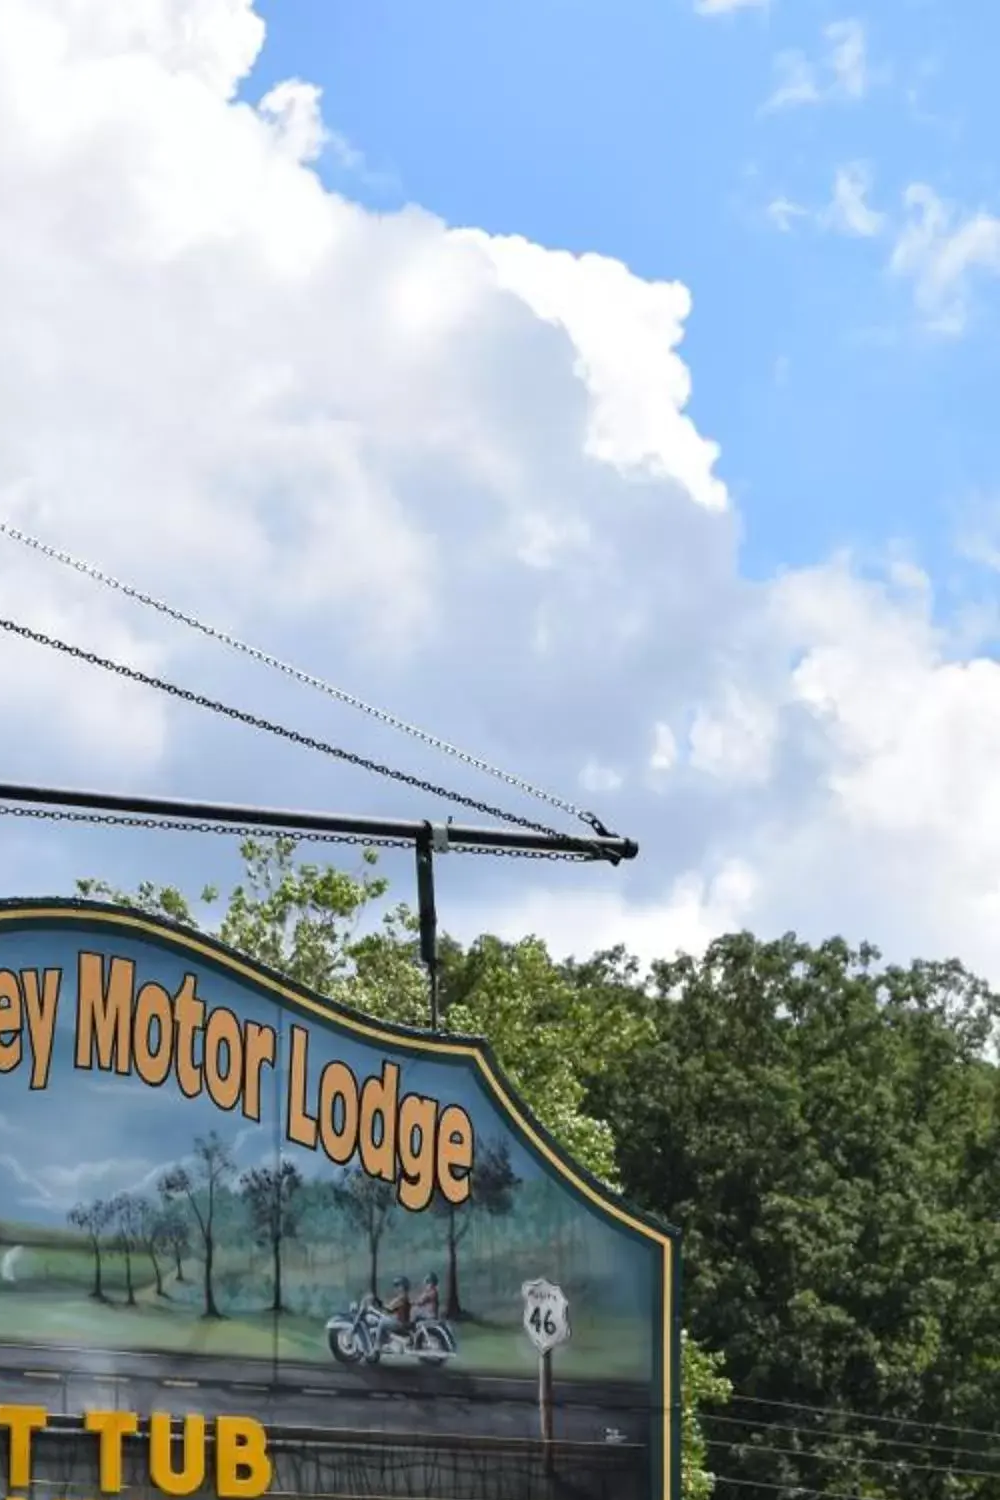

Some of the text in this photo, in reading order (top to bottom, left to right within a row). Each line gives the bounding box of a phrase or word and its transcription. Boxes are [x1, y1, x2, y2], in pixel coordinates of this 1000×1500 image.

[74, 950, 277, 1123] Motor
[286, 1024, 474, 1212] Lodge
[530, 1306, 557, 1336] 46
[85, 1411, 273, 1498] TUB
